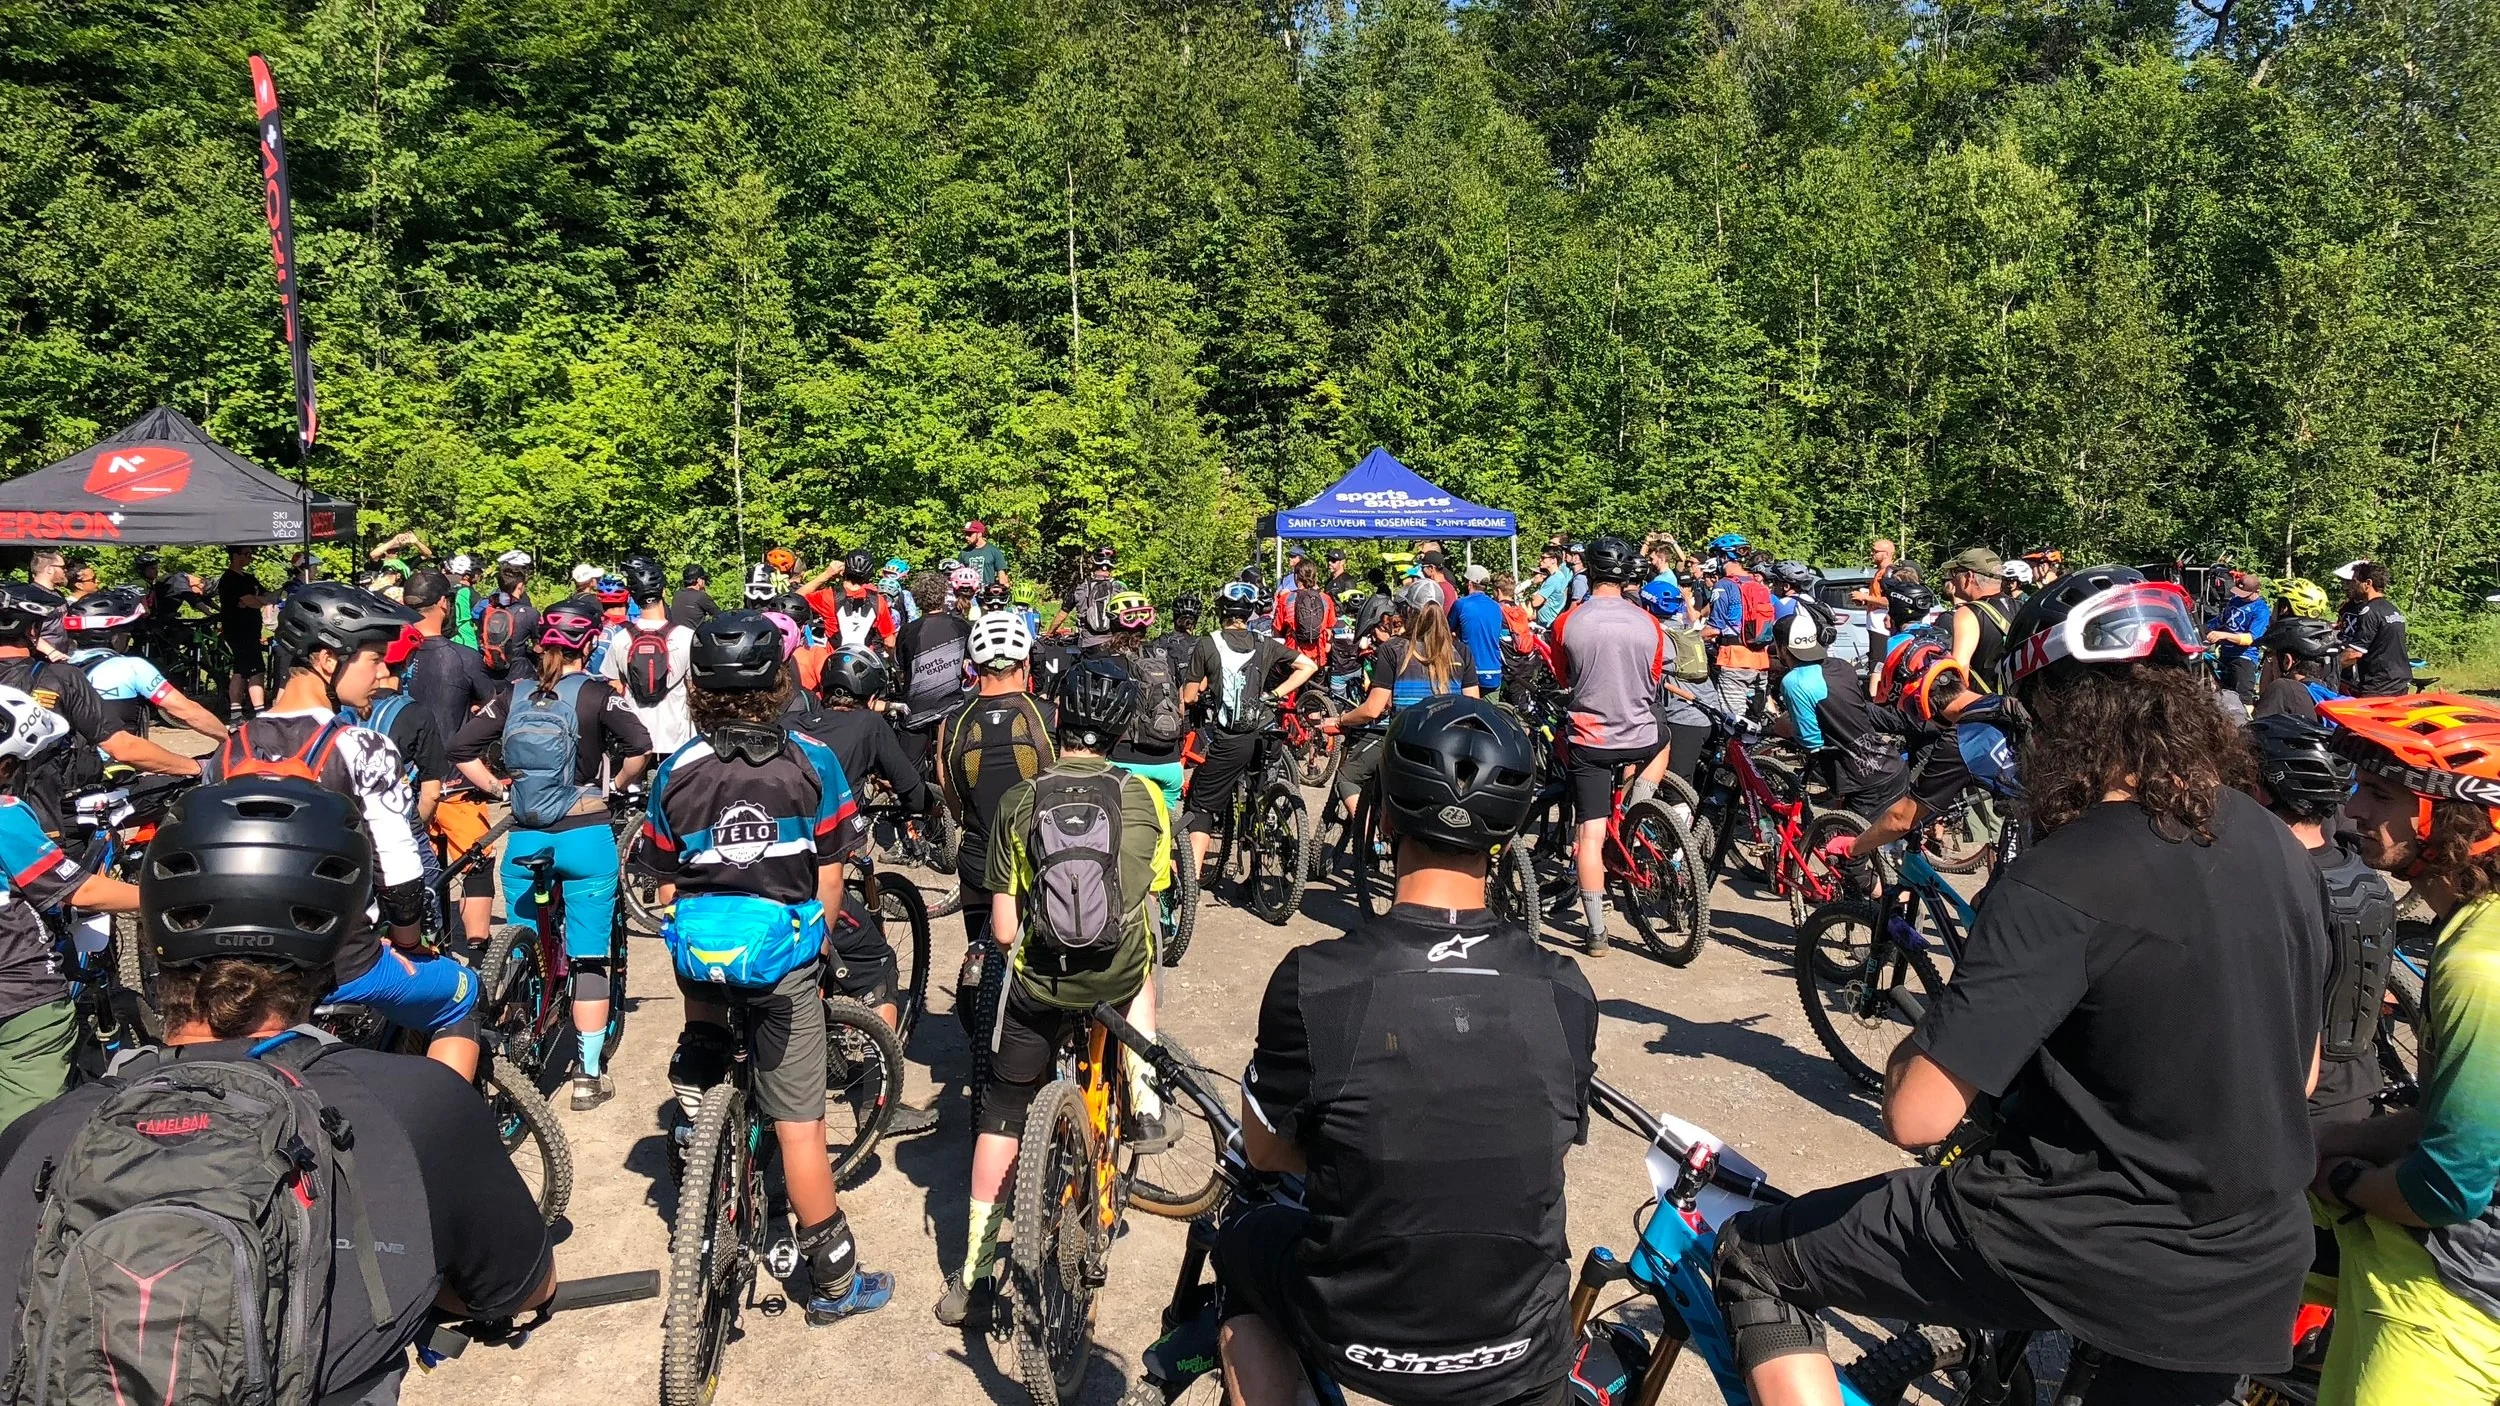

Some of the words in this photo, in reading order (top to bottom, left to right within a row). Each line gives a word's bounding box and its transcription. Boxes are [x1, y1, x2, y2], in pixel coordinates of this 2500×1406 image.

[1335, 489, 1409, 502] sports
[1364, 497, 1451, 509] experts
[273, 511, 288, 520] SKI
[1288, 518, 1367, 528] SAINT-SAUVEUR
[1374, 516, 1428, 528] ROSEMÈRE
[1435, 517, 1507, 528] SAINT-JÉRÔME
[272, 520, 303, 529] SNOW
[1890, 591, 1914, 605] GIRO
[914, 657, 944, 674] sports
[926, 657, 961, 676] experts
[18, 706, 42, 737] POC
[717, 825, 770, 844] VÉLO
[215, 934, 275, 947] GIRO
[136, 1113, 209, 1135] CAMELBAK
[1345, 1337, 1532, 1374] alpinestars
